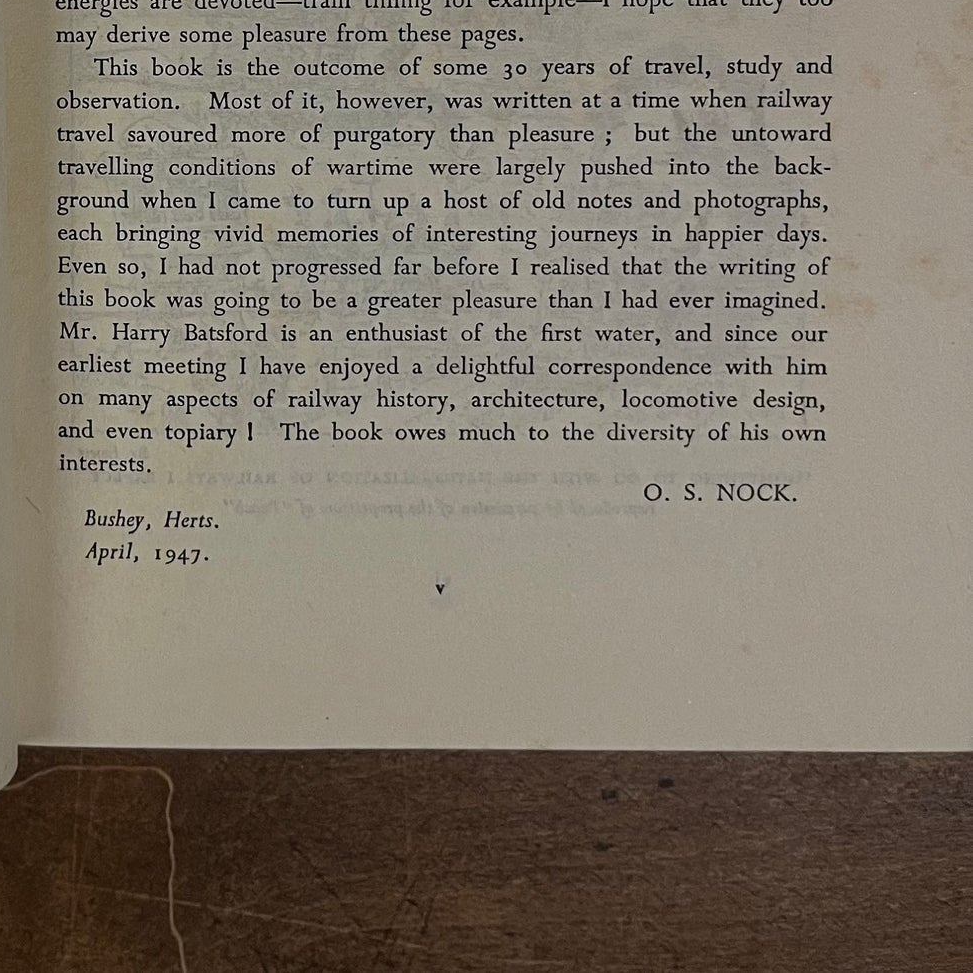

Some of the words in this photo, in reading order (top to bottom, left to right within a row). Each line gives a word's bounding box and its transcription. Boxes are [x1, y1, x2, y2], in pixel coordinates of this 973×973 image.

[56, 31, 97, 50] may
[107, 24, 170, 43] derive
[180, 31, 232, 42] some
[242, 23, 326, 50] pleasure
[337, 23, 388, 42] from
[398, 23, 451, 42] these
[461, 30, 523, 50] pages.
[58, 222, 102, 241] each
[116, 222, 201, 249] bringing
[214, 223, 264, 242] vivid
[277, 225, 378, 242] memories
[393, 223, 415, 242] of
[426, 225, 537, 250] interesting
[549, 225, 637, 249] journeys
[652, 225, 672, 242] in
[685, 223, 763, 249] happier
[777, 223, 827, 250] days.
[59, 393, 83, 405] on
[99, 394, 152, 414] many
[167, 393, 237, 414] aspects
[254, 389, 275, 407] of
[288, 388, 362, 414] railway
[377, 388, 455, 415] history,
[472, 389, 604, 412] architecture,
[622, 389, 737, 407] locomotive
[753, 389, 825, 416] design,
[644, 483, 669, 501] O.
[684, 483, 702, 501] S.
[716, 483, 796, 502] NOCK.
[84, 509, 150, 534] Bushey,
[164, 511, 218, 528] Herts.
[85, 542, 138, 566] April,
[155, 549, 208, 565] 1947.
[436, 584, 445, 595] v
